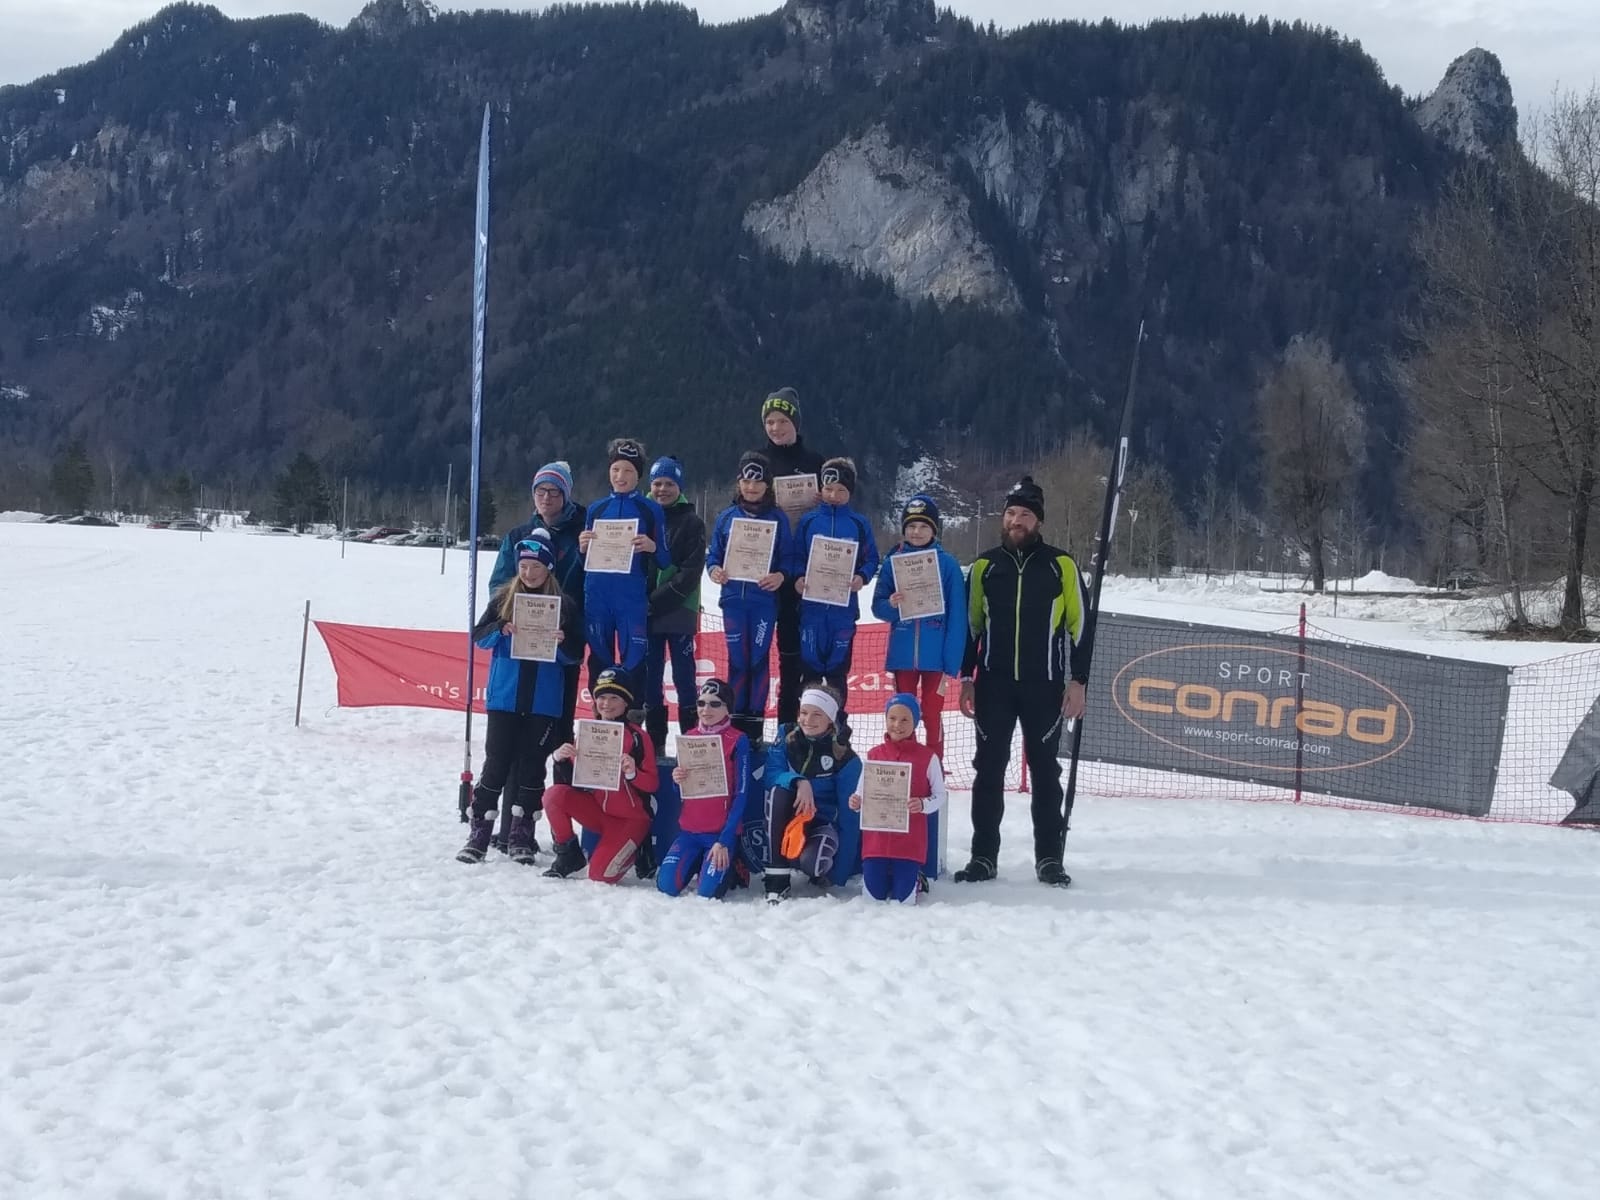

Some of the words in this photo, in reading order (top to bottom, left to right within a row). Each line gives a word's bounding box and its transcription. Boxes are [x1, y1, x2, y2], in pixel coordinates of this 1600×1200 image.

[1219, 661, 1311, 689] SPORT
[1128, 677, 1397, 744] conrad
[1183, 725, 1331, 755] www.sport-conrad.com
